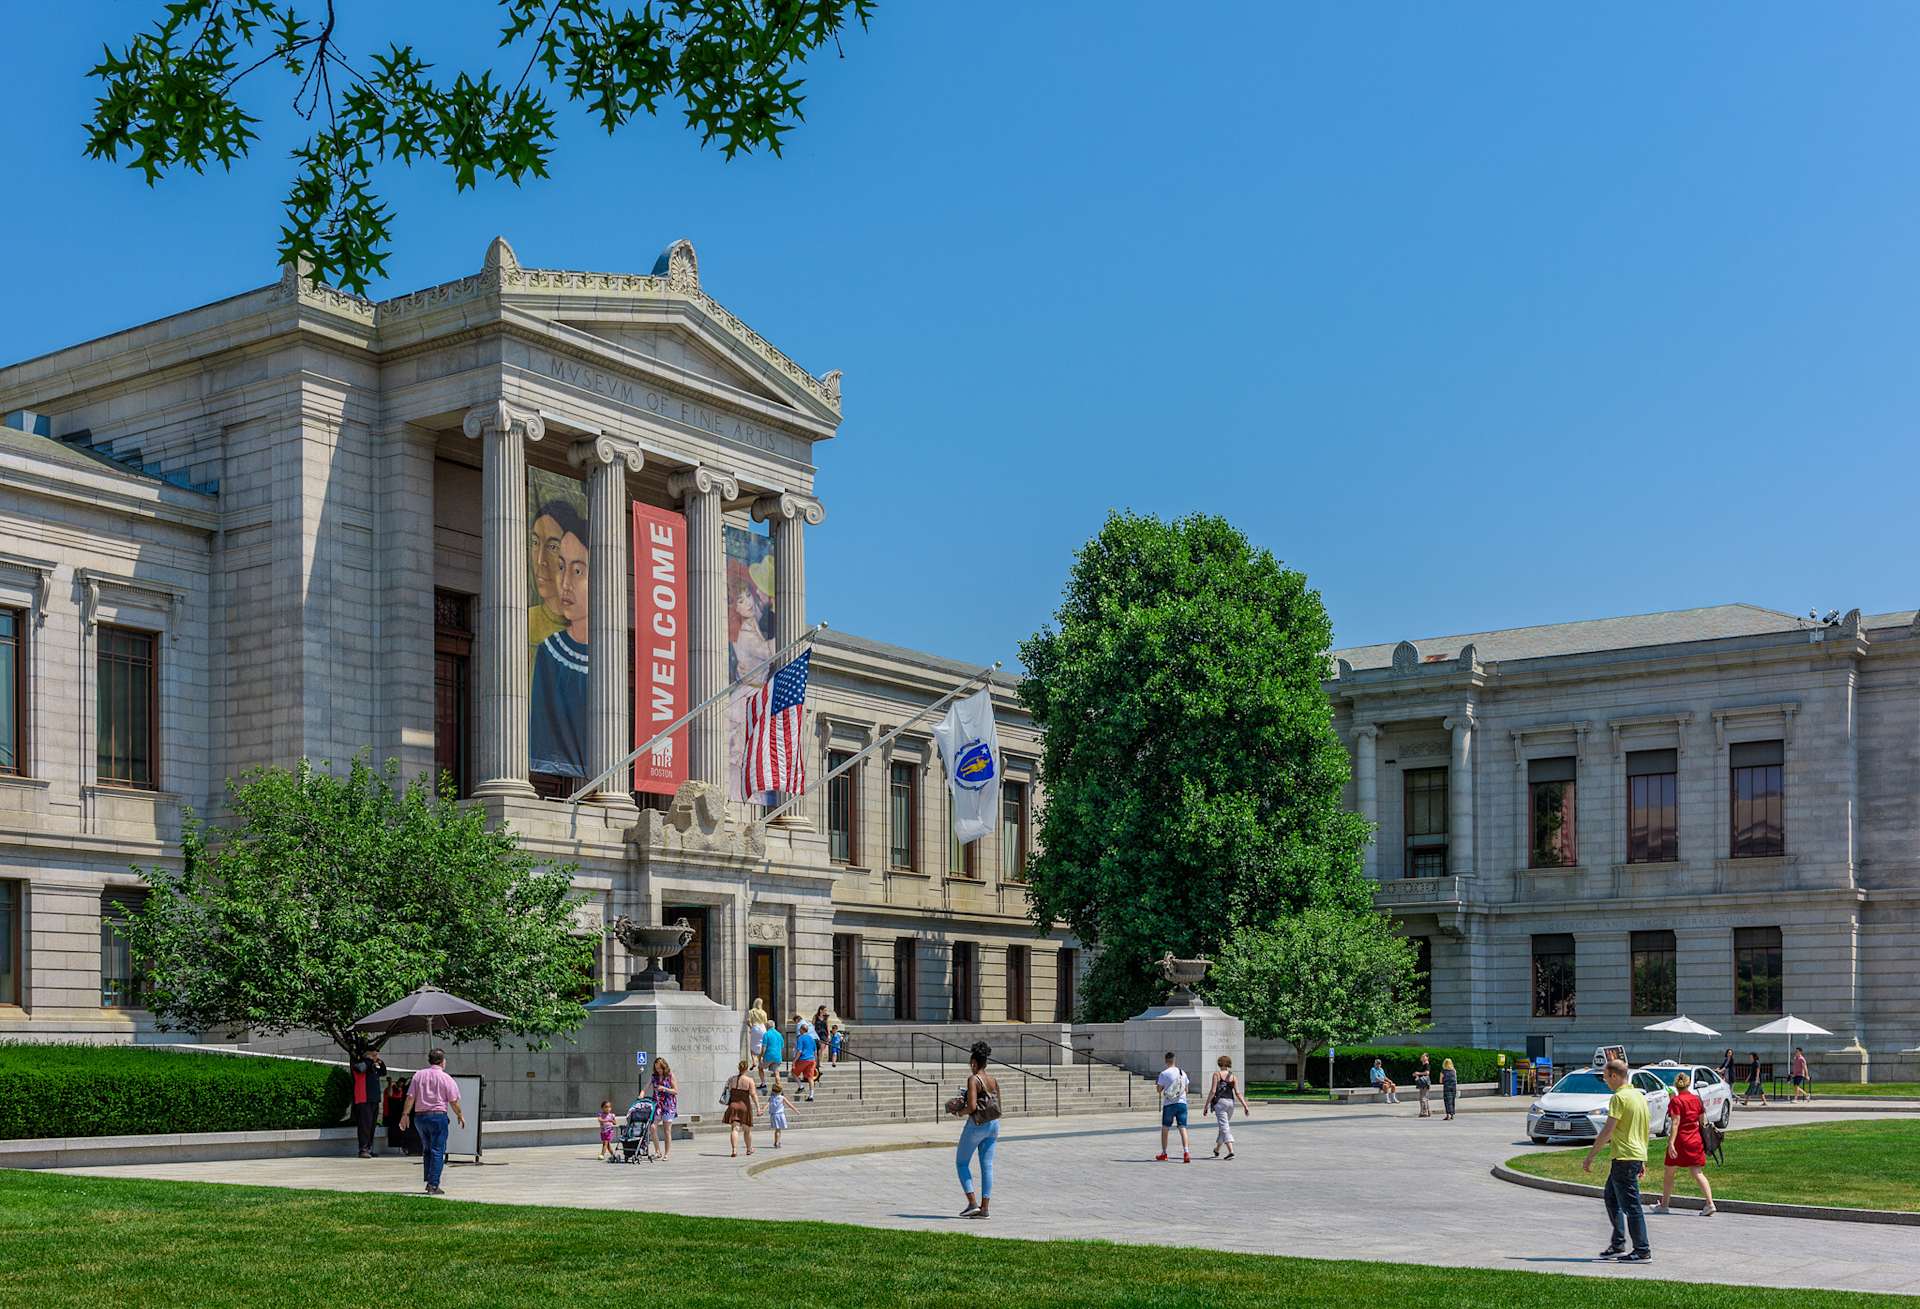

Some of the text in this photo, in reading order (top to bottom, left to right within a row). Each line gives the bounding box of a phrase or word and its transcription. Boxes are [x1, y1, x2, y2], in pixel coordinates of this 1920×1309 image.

[550, 357, 776, 451] MVSEVM OF FINE ARTS
[649, 522, 676, 721] WELCOME
[650, 767, 673, 779] BOSTON
[691, 1026, 715, 1034] AMERICA
